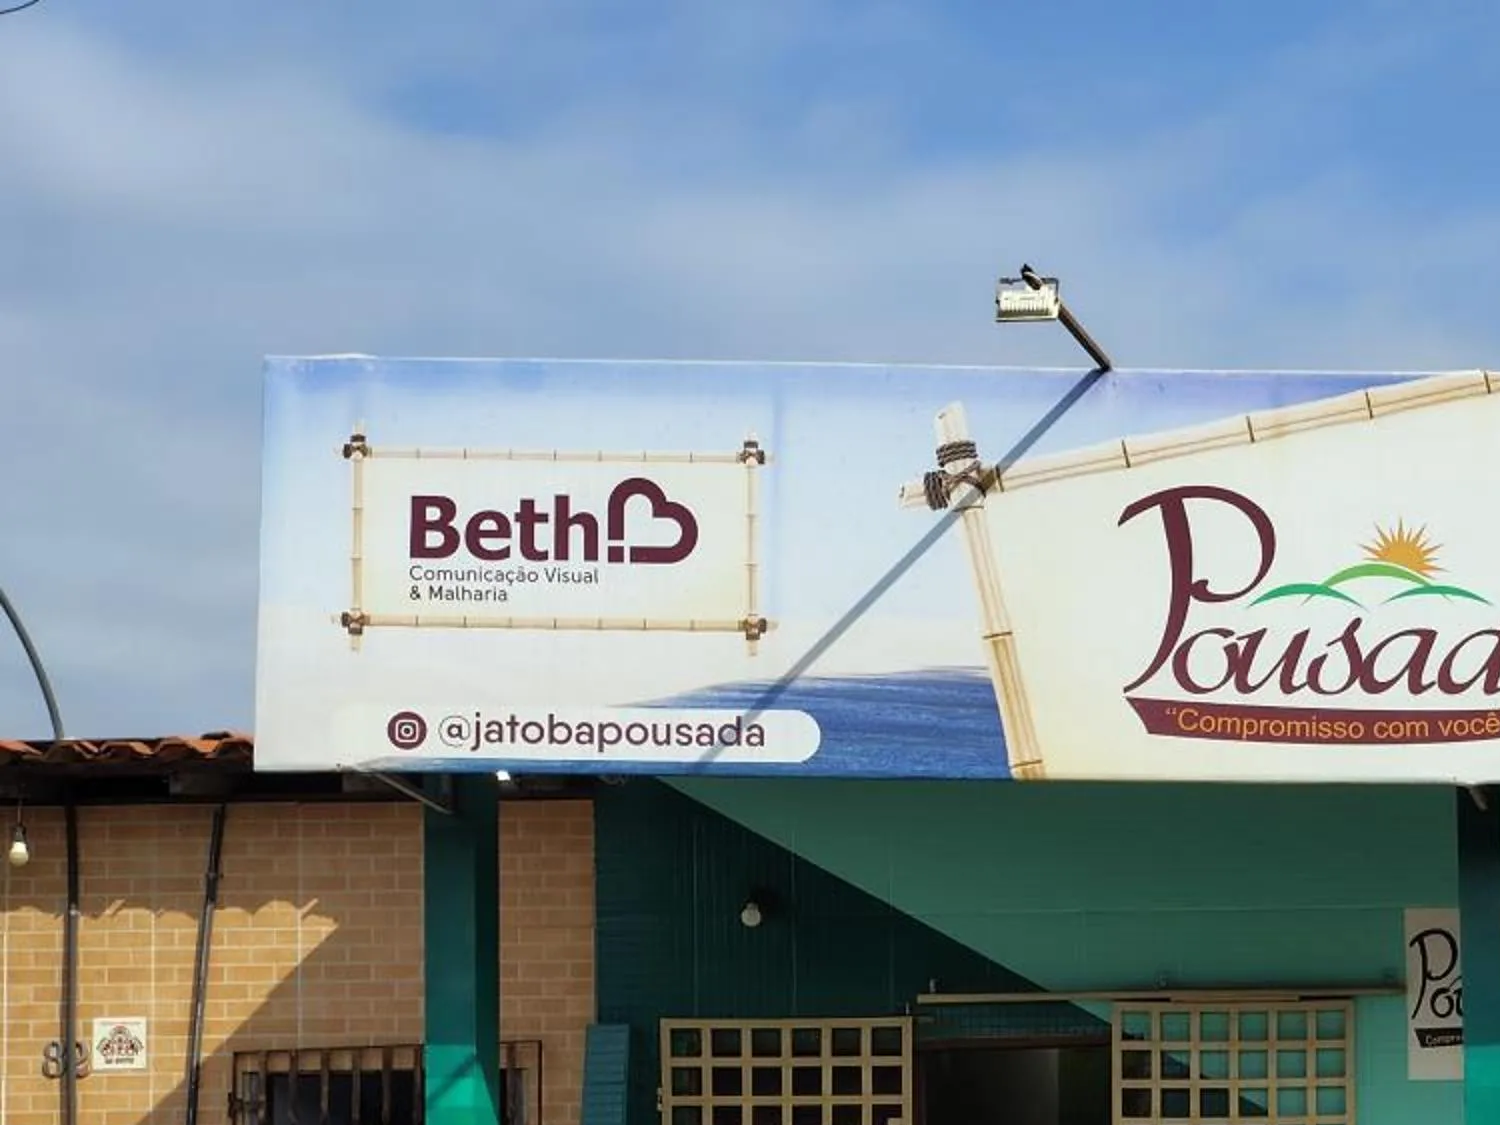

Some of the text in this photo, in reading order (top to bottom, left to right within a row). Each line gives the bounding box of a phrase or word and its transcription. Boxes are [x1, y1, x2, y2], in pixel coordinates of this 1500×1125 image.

[409, 565, 600, 587] Comunicação Visual
[409, 584, 509, 602] & Malharia
[438, 711, 766, 752] @jatobapousada
[1373, 716, 1430, 740] com
